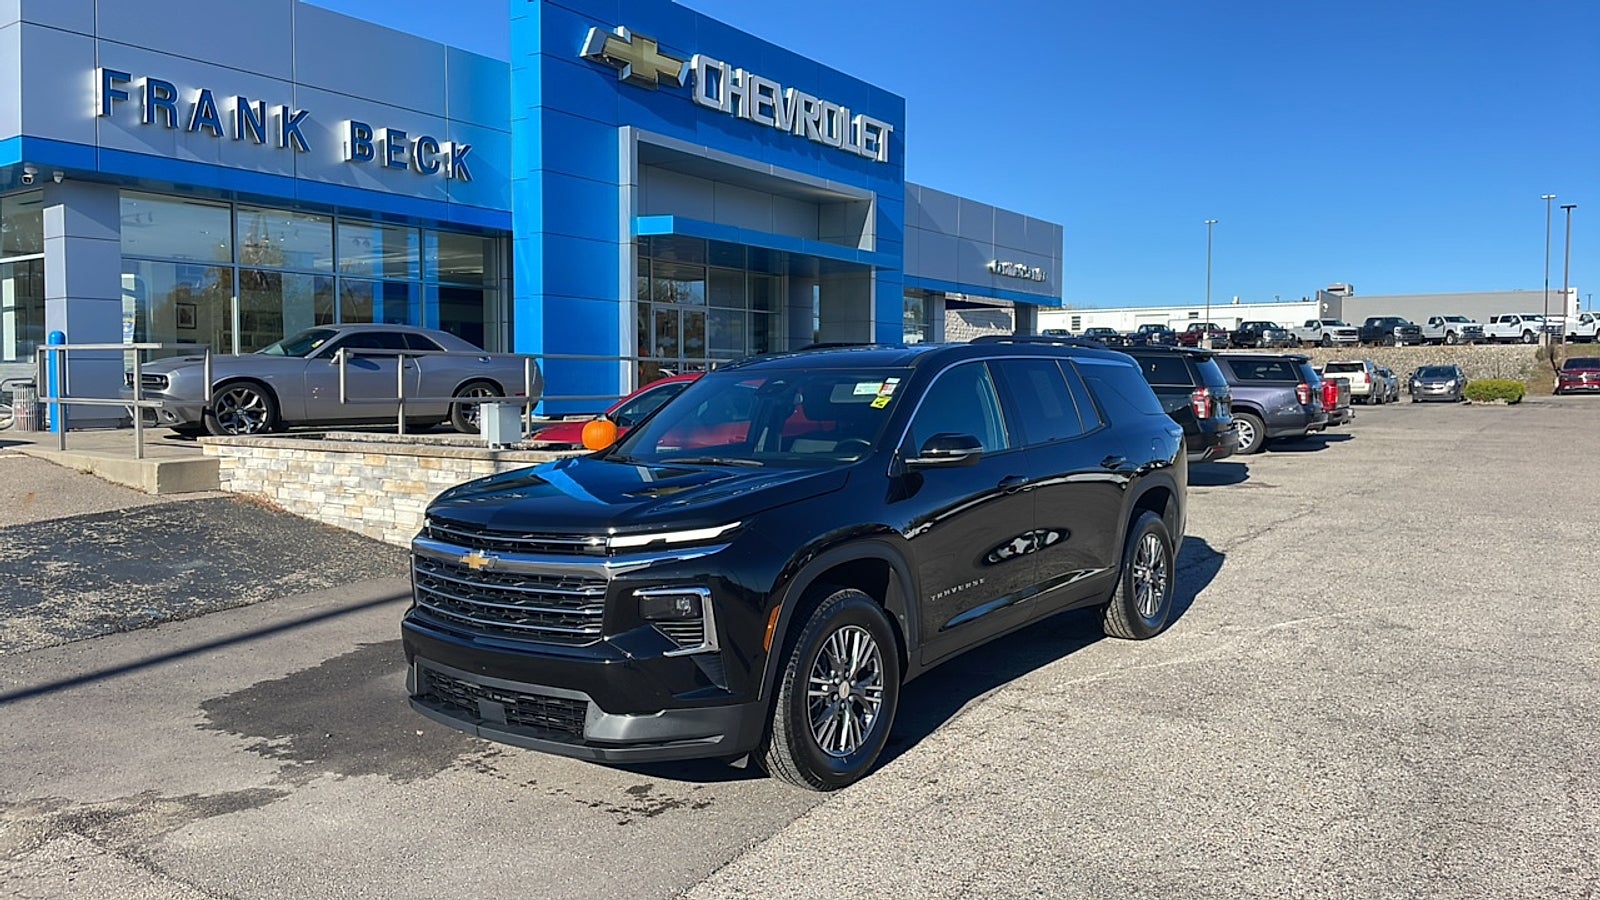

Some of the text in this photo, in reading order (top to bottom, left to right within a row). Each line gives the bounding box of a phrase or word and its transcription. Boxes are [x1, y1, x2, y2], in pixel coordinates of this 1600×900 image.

[97, 67, 473, 182] FRANK BECK
[691, 54, 893, 163] CHEVROLET
[930, 578, 984, 601] TRAVERSE
